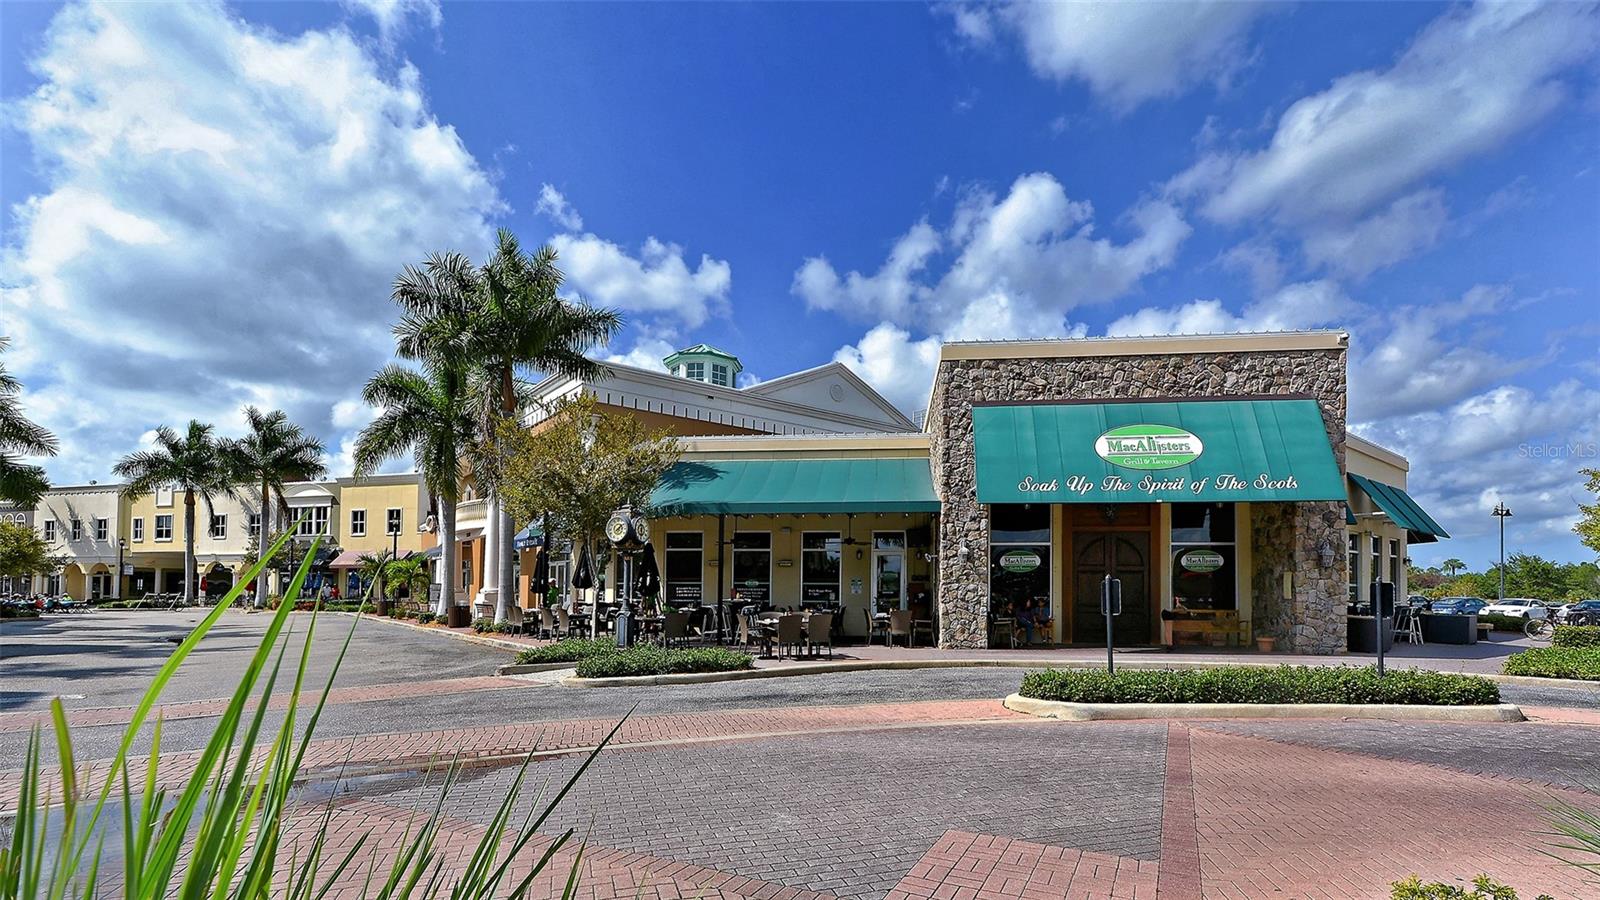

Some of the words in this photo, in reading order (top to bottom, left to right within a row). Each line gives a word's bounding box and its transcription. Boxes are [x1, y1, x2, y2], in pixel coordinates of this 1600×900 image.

[1107, 436, 1191, 455] MacAllisters
[1123, 457, 1143, 465] Grill
[1150, 456, 1179, 465] Tavern
[1018, 476, 1059, 492] Soak
[1066, 475, 1094, 495] Up
[1100, 475, 1132, 491] The
[1138, 475, 1185, 494] Spirit
[1190, 477, 1209, 494] of
[1215, 474, 1248, 490] The
[1253, 473, 1298, 489] Scots
